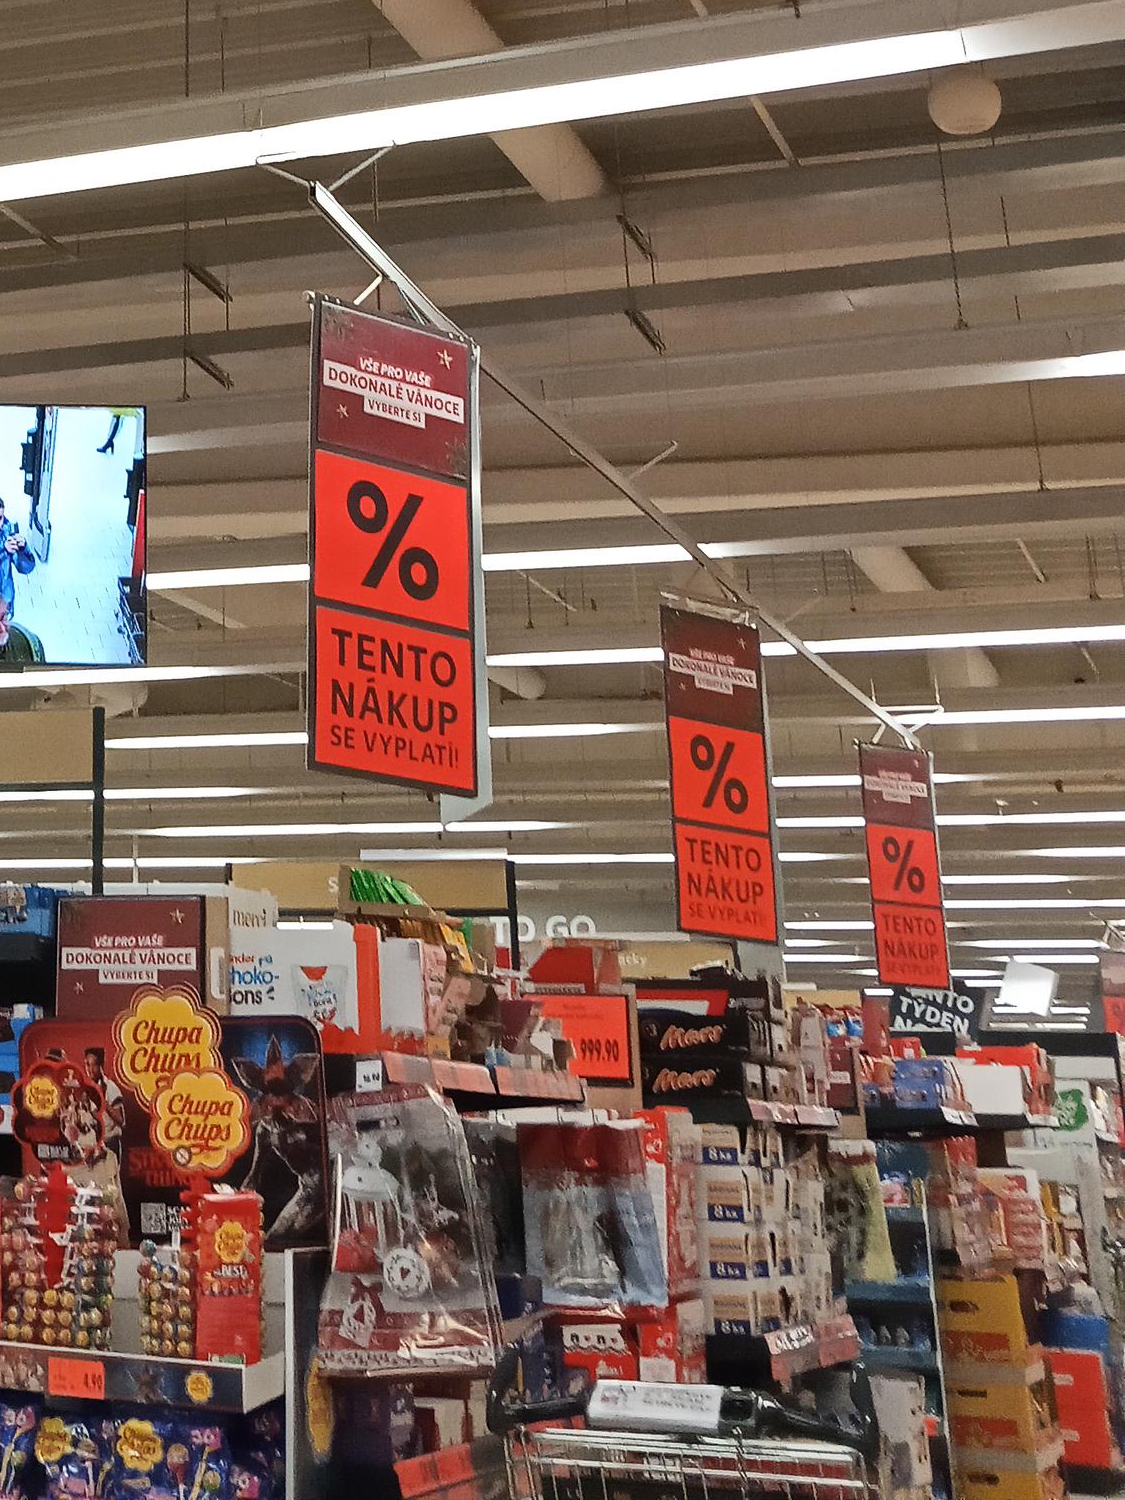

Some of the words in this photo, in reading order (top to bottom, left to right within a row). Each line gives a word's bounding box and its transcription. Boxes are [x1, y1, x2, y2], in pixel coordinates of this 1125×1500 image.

[359, 356, 379, 373] VŠE
[380, 364, 403, 380] PRO
[405, 370, 433, 388] VAŠE
[328, 367, 403, 400] DOKONALÉ
[406, 388, 460, 417] VÁNOCE
[368, 398, 411, 420] VYBERTE
[412, 411, 422, 423] SI
[331, 627, 457, 688] TENTO
[331, 677, 458, 736] NÁKUP
[331, 724, 356, 750] SE
[363, 730, 459, 769] VYPLATÍ!
[684, 837, 762, 872] TENTO
[686, 868, 765, 905] NÁKUP
[688, 902, 705, 919] SE
[489, 916, 536, 947] TO
[546, 914, 597, 939] GO
[881, 913, 937, 937] TENTO
[94, 935, 114, 948] VŠE
[115, 935, 137, 948] PRO
[138, 933, 164, 947] VAŠE
[883, 939, 938, 964] NÁKUP
[65, 949, 137, 965] DOKONALÉ
[138, 950, 192, 966] VÁNOCE
[103, 969, 144, 981] VYBERTE
[132, 1019, 203, 1049] Chupa
[579, 1037, 619, 1063] 999.90
[167, 1094, 234, 1118] Chupa
[164, 1116, 232, 1147] Chups
[709, 1147, 718, 1161] 8
[714, 1204, 723, 1220] 8
[716, 1262, 726, 1278] 8
